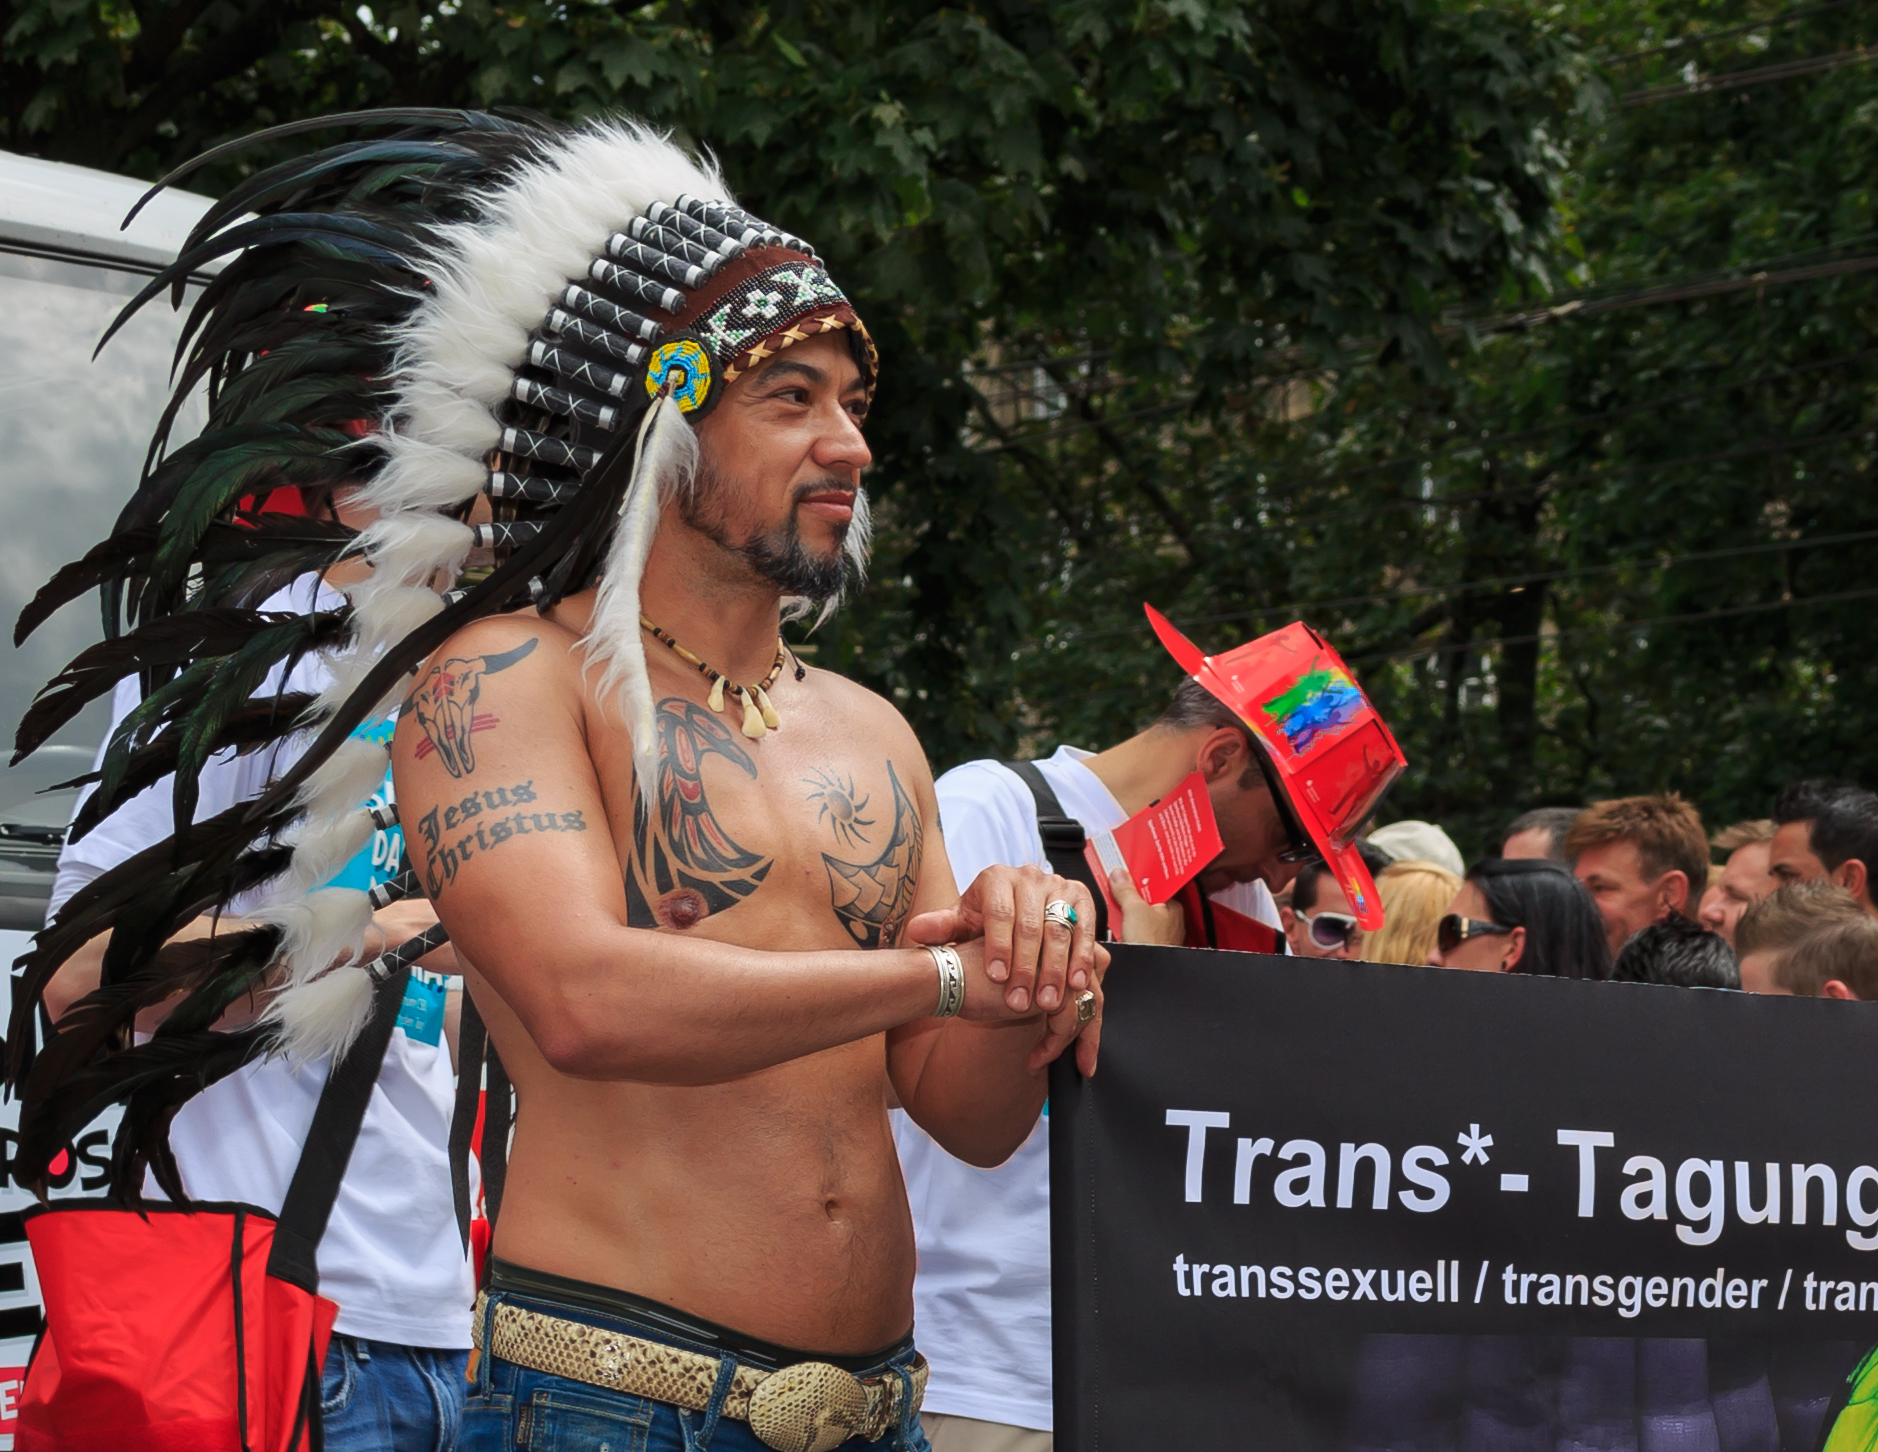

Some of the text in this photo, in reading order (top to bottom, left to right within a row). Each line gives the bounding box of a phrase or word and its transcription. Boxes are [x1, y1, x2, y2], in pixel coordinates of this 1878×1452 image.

[418, 780, 538, 858] Jesus
[427, 809, 588, 900] Christus
[1173, 1254, 1459, 1303] transsexuell
[1503, 1264, 1767, 1318] transgender
